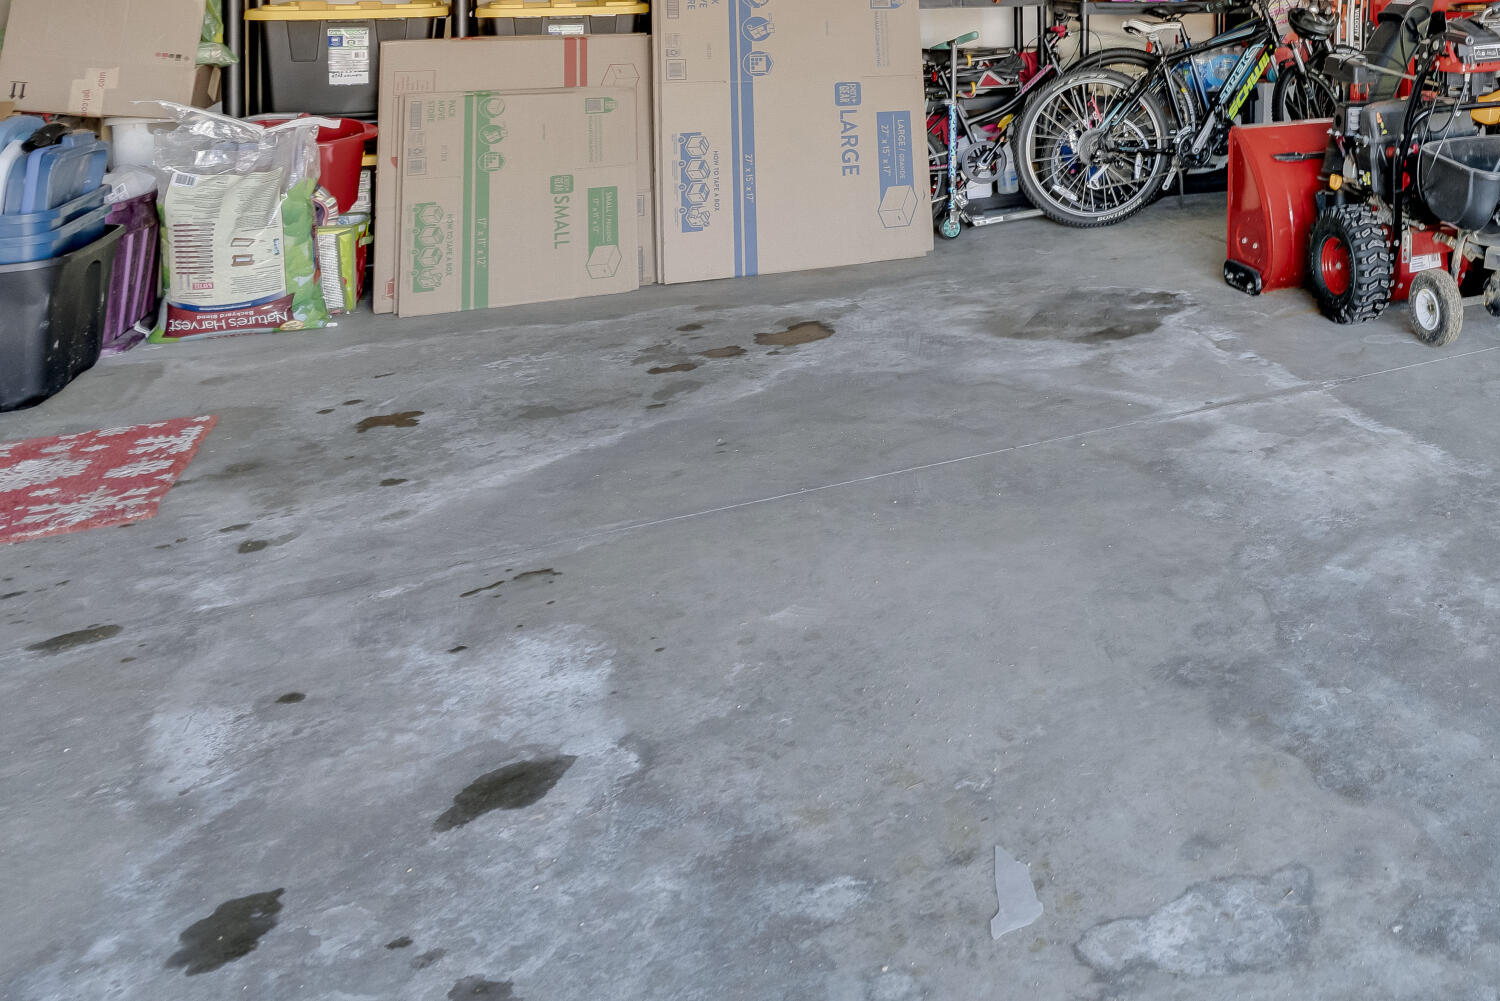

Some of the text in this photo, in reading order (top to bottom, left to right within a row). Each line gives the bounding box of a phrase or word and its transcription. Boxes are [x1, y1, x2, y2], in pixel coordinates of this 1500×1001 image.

[1224, 54, 1250, 96] TREK
[839, 85, 850, 103] GEAR
[427, 100, 436, 123] STORE
[437, 100, 446, 121] MOVE
[448, 99, 457, 119] PACK
[840, 109, 860, 177] LARGE
[897, 119, 907, 147] LARGE
[713, 167, 719, 176] TO
[554, 195, 570, 249] SMALL
[169, 311, 288, 332] Nature's Harvest
